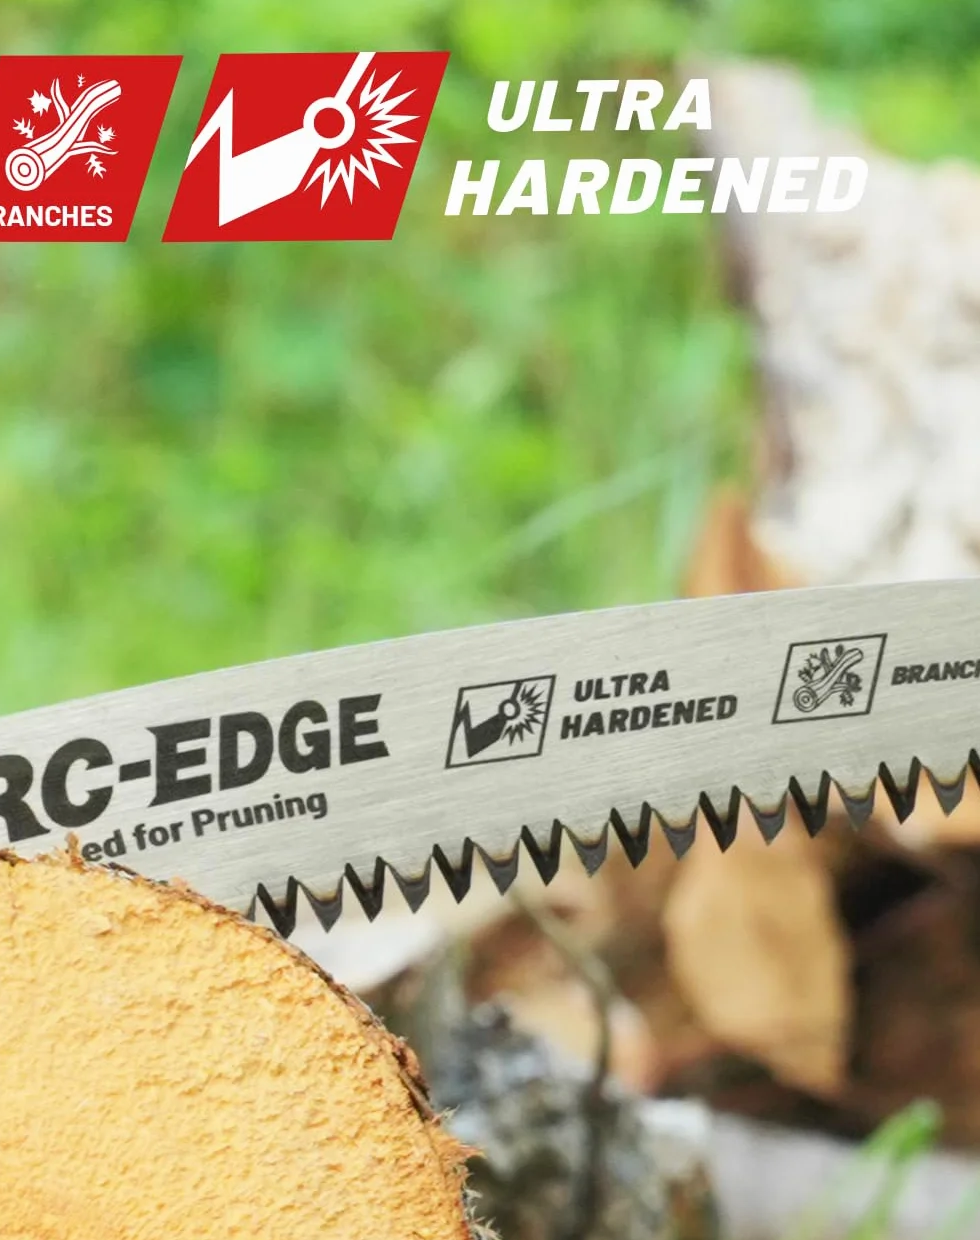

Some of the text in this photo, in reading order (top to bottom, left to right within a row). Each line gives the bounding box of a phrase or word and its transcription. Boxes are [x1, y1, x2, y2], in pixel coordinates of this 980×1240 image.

[573, 669, 671, 702] ULTRA
[560, 694, 739, 740] HARDENED
[132, 822, 183, 850] for
[193, 792, 328, 837] Pruning
